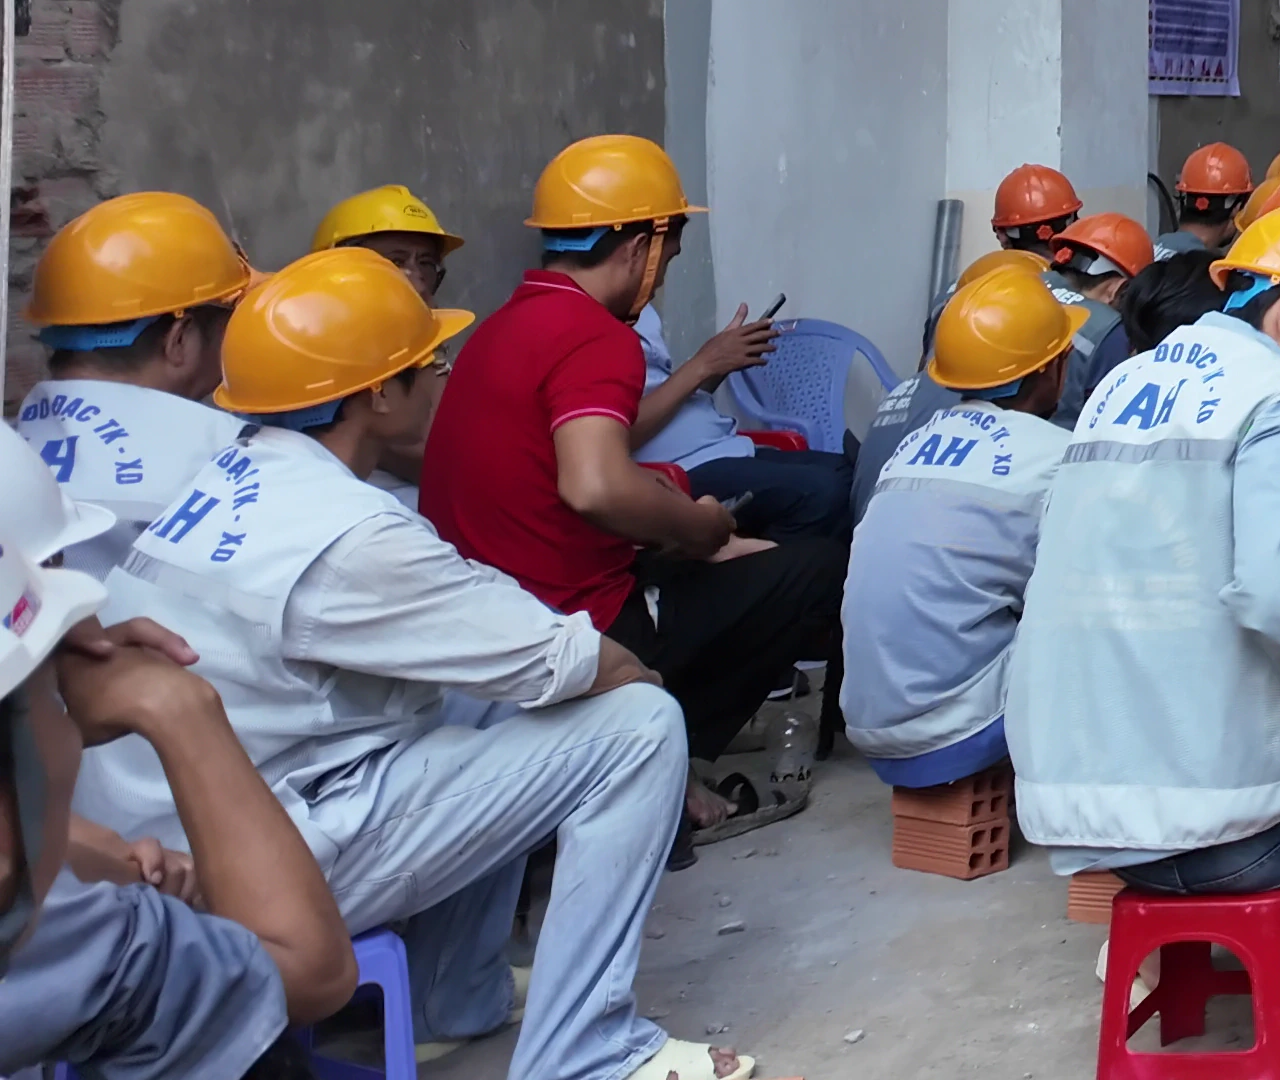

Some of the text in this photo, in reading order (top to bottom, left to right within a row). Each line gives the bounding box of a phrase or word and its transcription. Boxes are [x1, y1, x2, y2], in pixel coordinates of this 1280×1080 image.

[1112, 378, 1189, 430] AH
[93, 418, 129, 446] TK
[114, 458, 144, 485] XD
[905, 433, 980, 467] AH
[991, 453, 1013, 476] XD
[210, 531, 247, 563] XD
